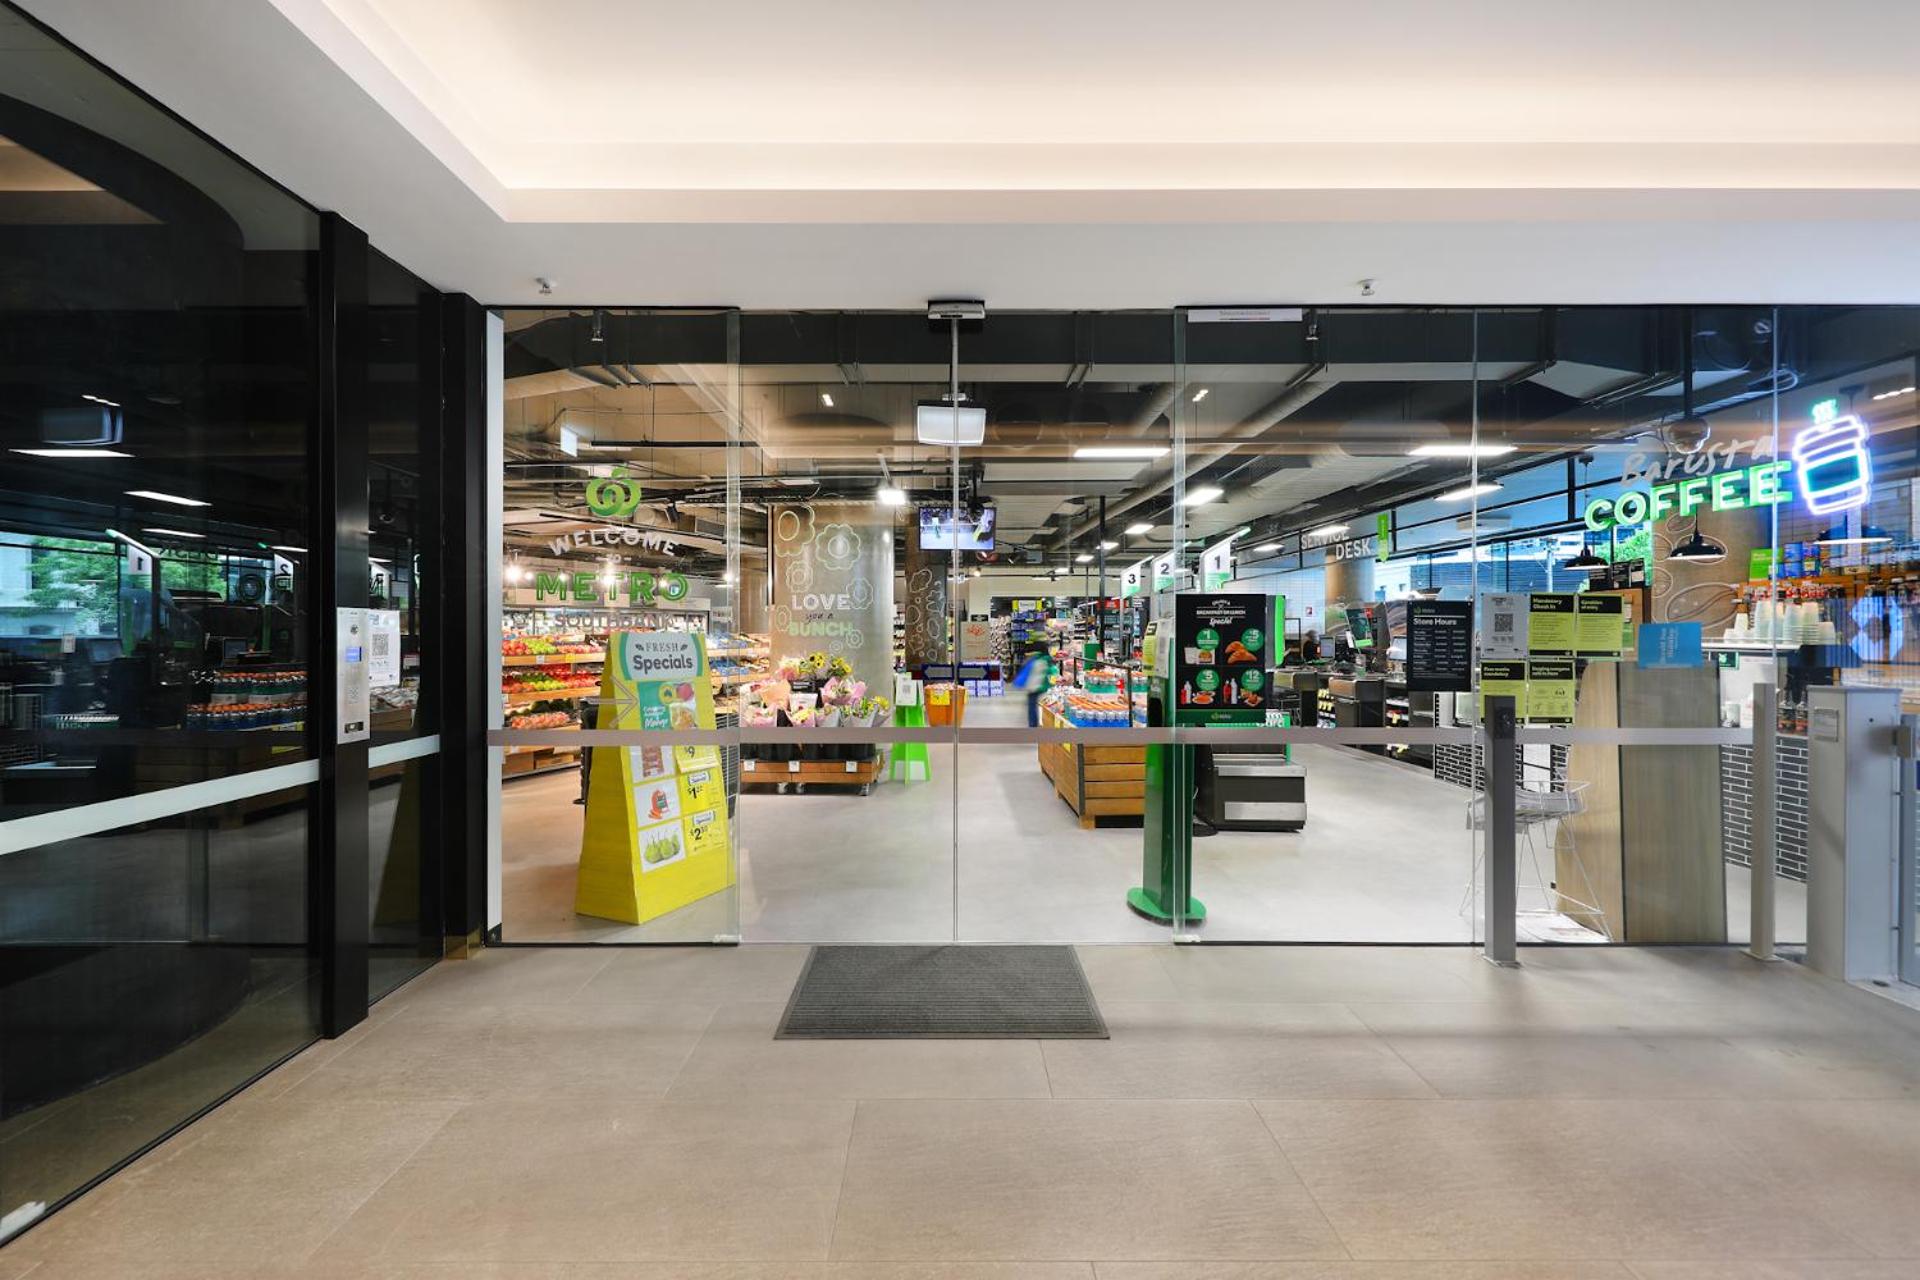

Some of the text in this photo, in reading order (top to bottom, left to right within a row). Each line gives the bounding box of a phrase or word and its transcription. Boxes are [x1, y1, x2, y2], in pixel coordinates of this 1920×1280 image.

[1584, 459, 1794, 532] COFFEE
[547, 525, 682, 557] WELCOME
[1335, 537, 1372, 560] DESK
[1160, 562, 1170, 575] 2
[1214, 555, 1221, 570] 1
[536, 571, 689, 602] METRO
[1128, 574, 1136, 584] 3
[791, 593, 851, 610] LOVE
[788, 622, 854, 637] BUNCH
[1413, 617, 1457, 626] Store Hours
[633, 654, 694, 674] Specials
